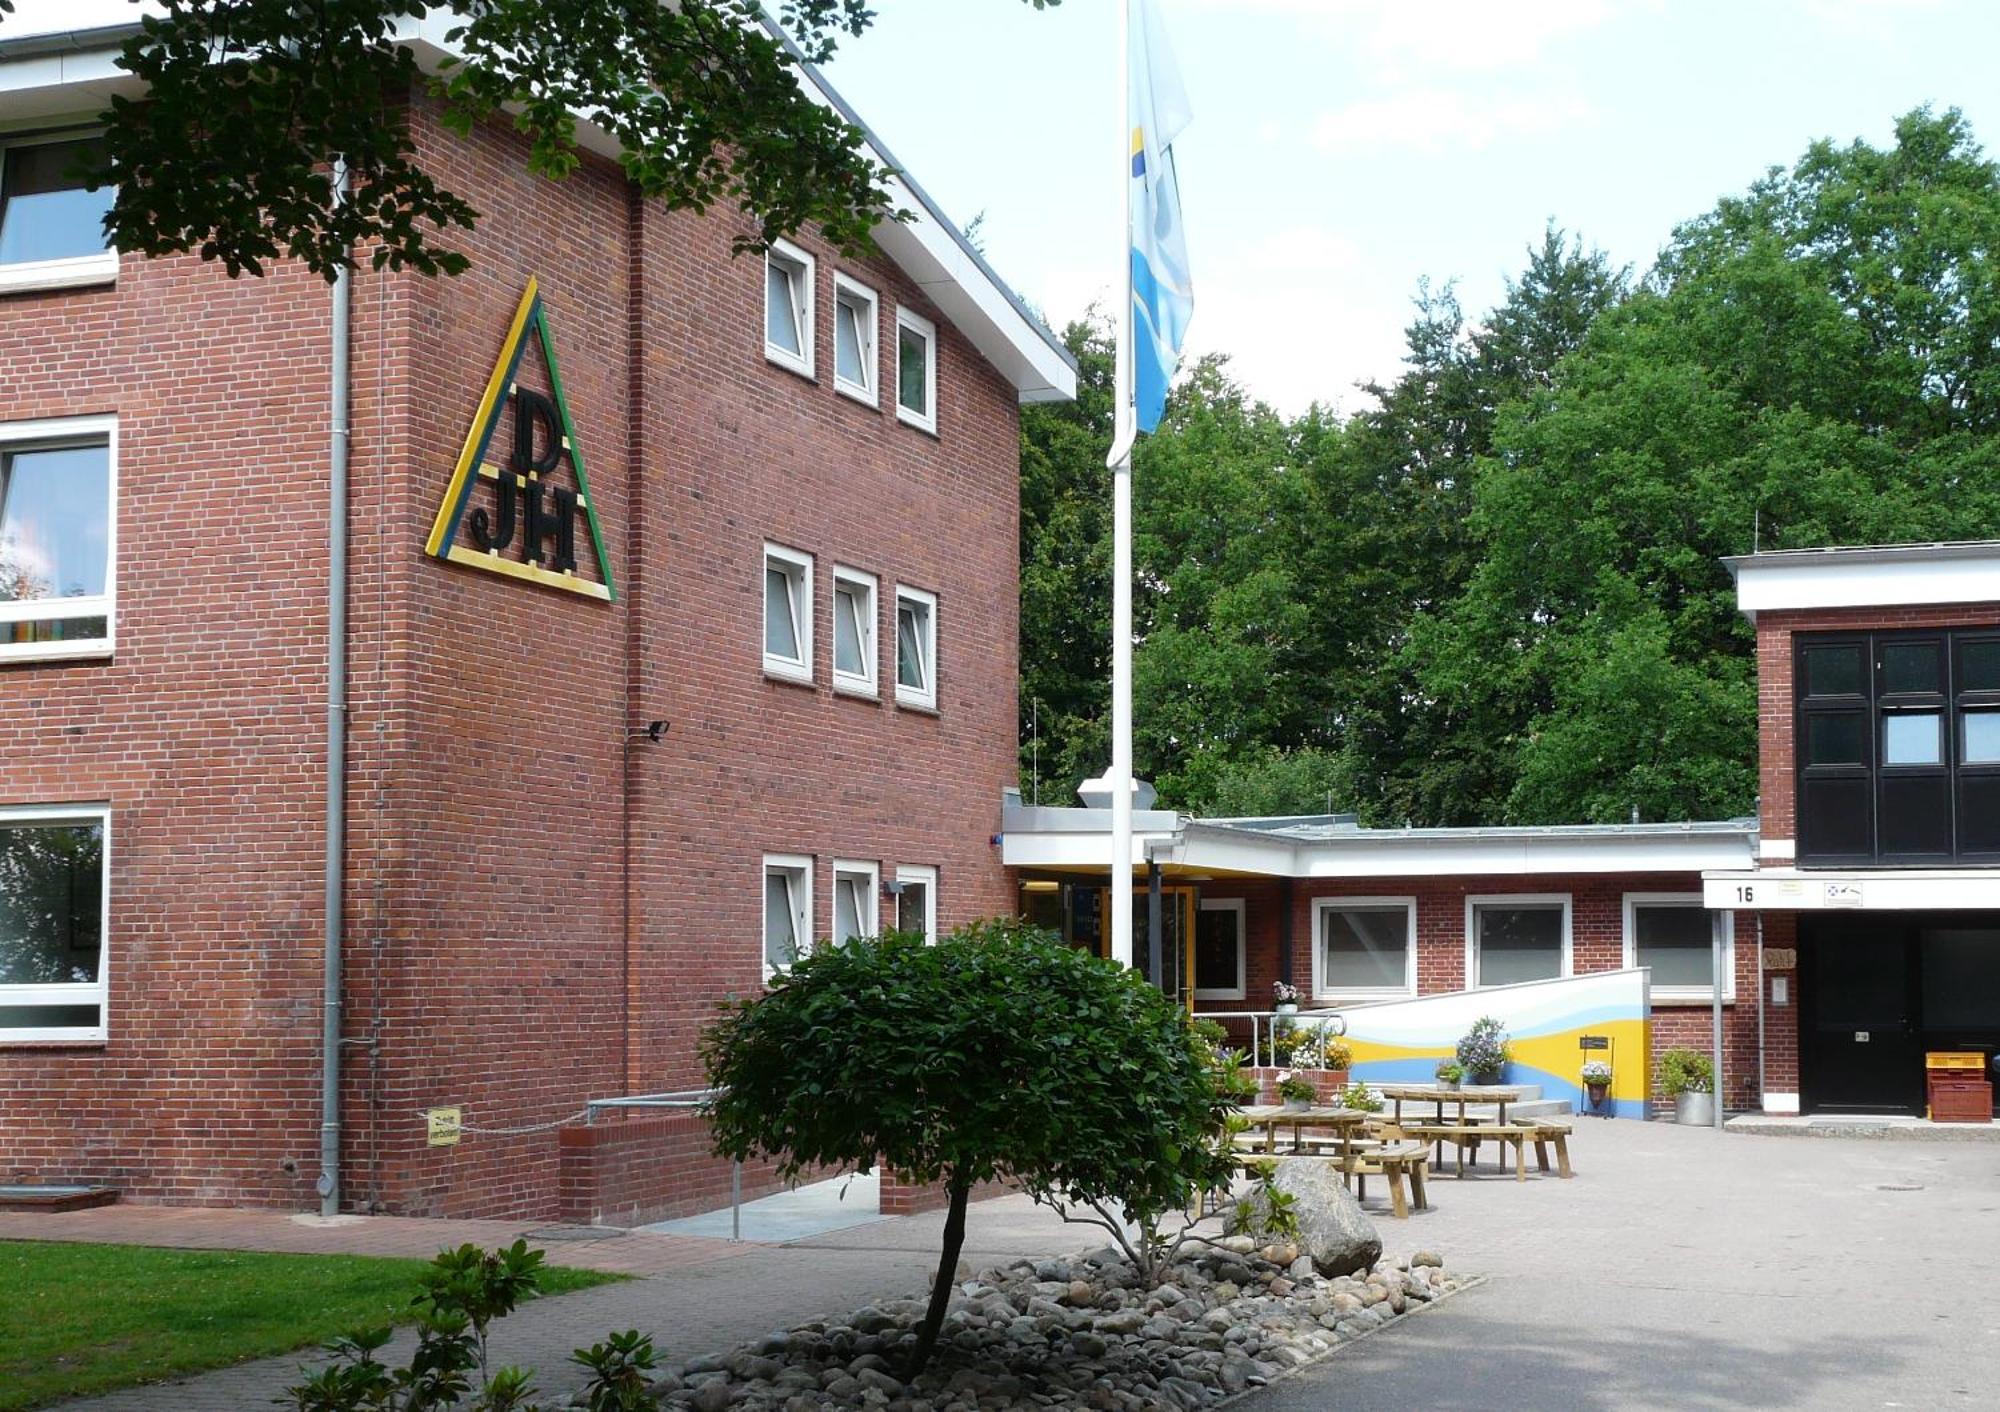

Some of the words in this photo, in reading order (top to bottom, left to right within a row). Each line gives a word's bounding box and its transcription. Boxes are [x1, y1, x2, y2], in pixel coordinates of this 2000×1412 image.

[512, 384, 564, 475] D
[470, 469, 577, 572] JH
[1736, 886, 1753, 903] 16
